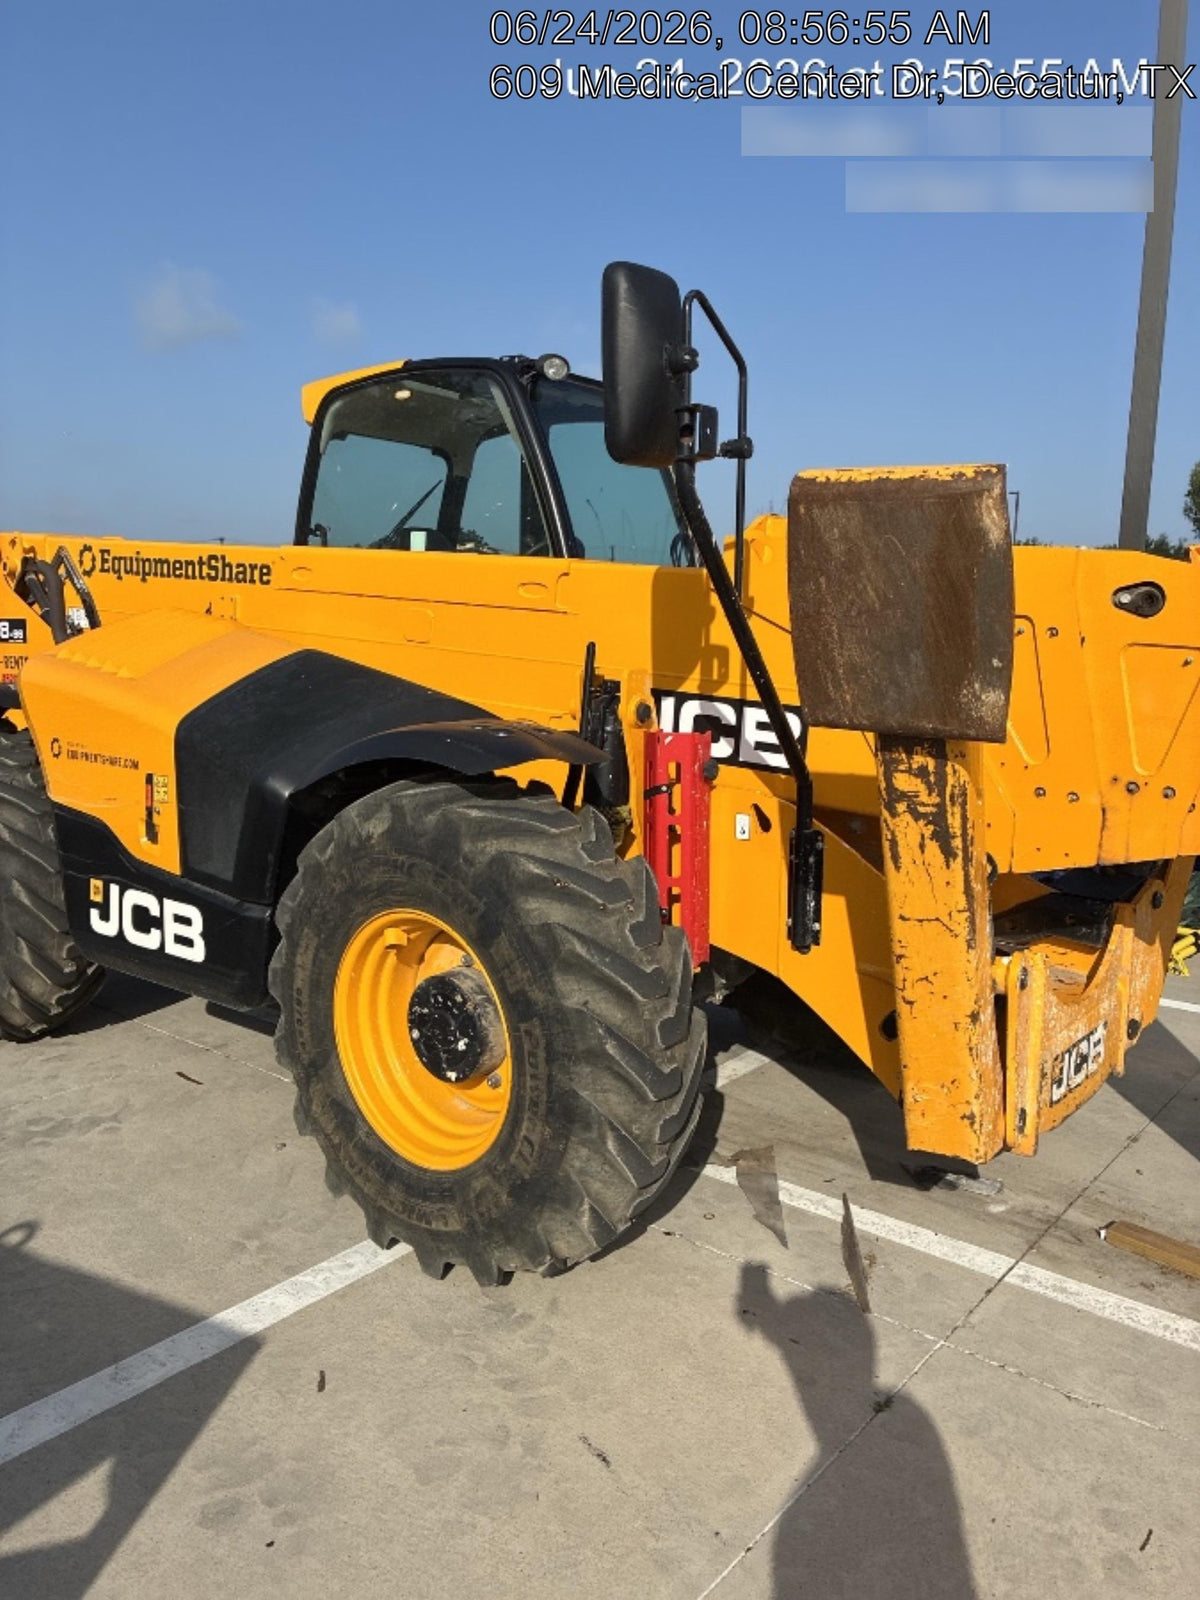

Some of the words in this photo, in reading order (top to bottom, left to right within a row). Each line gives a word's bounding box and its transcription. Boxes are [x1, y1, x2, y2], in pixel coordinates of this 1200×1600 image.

[99, 549, 272, 586] EquipmentShare
[89, 882, 206, 963] JCB
[1051, 1020, 1108, 1103] JCB
